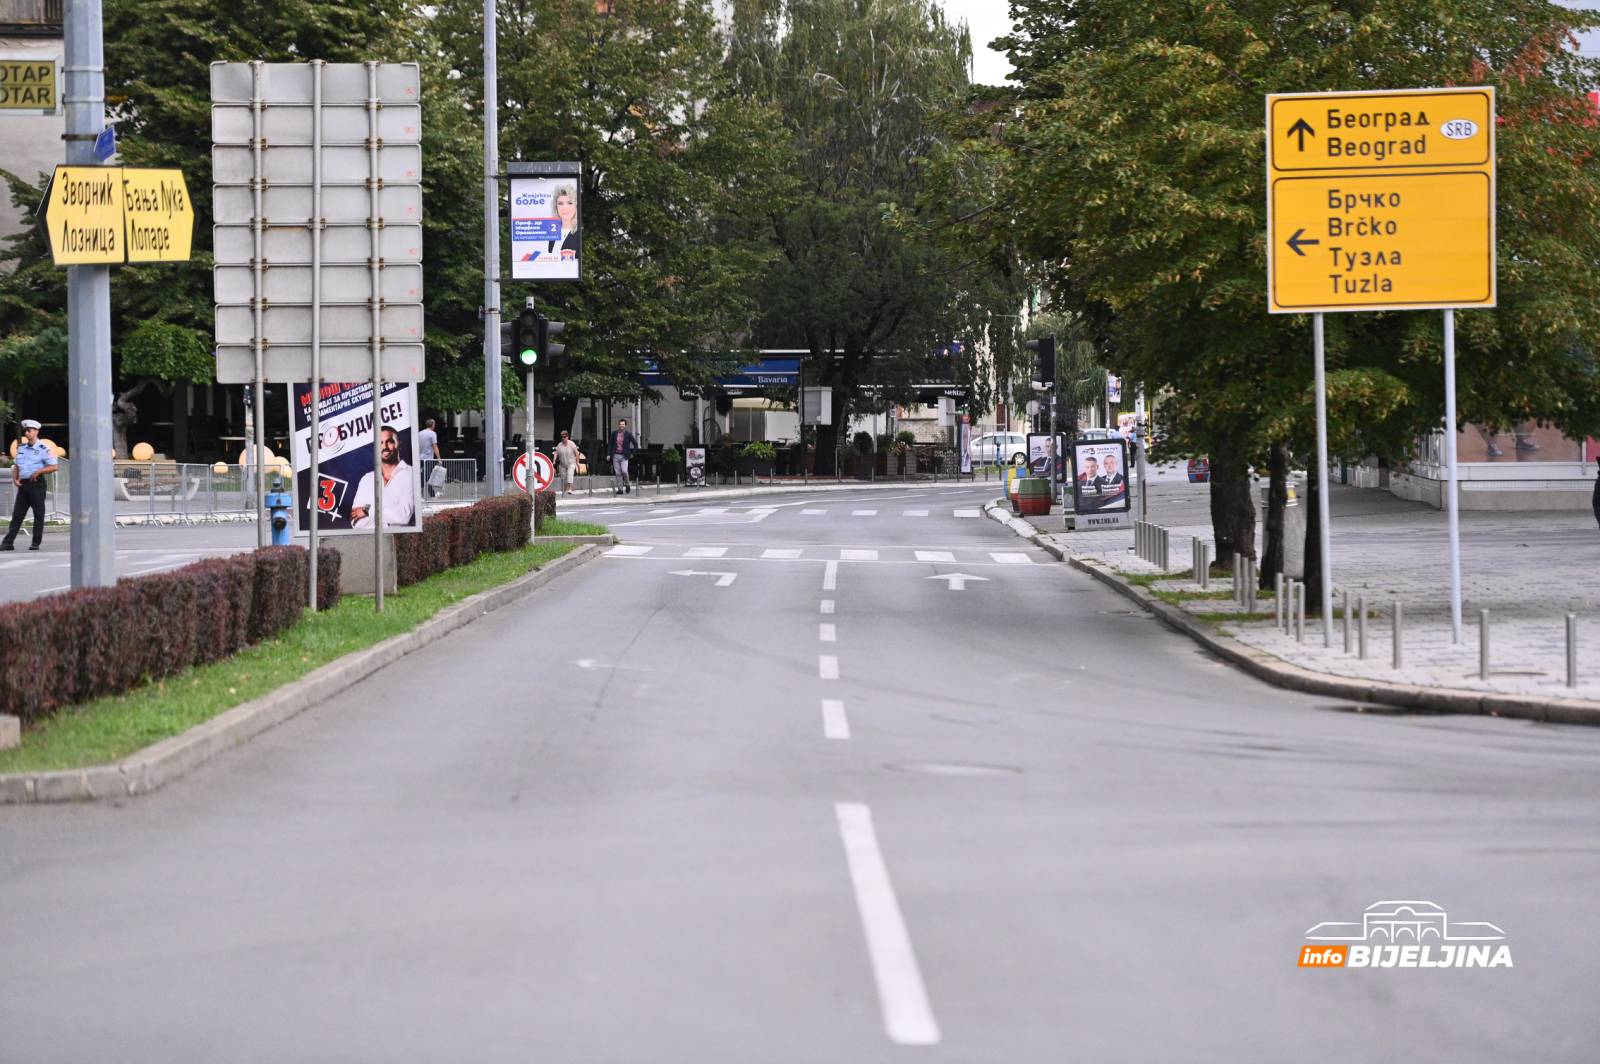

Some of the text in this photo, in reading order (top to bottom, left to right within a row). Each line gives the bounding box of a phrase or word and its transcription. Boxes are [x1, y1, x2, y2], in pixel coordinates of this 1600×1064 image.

[1327, 109, 1430, 132] Београд
[1446, 122, 1472, 136] SRB
[1327, 134, 1427, 161] Beograd
[62, 171, 113, 215] Зворник
[123, 180, 183, 219] Бања Лука
[515, 197, 545, 205] боље
[1328, 189, 1401, 213] Брчко
[62, 219, 115, 255] Лозница
[131, 218, 170, 259] Лопаре
[551, 223, 557, 232] 2
[1328, 216, 1397, 237] Brčko
[1329, 246, 1402, 272] Тузла
[1329, 273, 1393, 294] Tuzla
[758, 376, 788, 384] Bavaria
[300, 382, 341, 407] МЛОШ
[380, 401, 403, 424] СЕ!
[318, 479, 336, 511] 3
